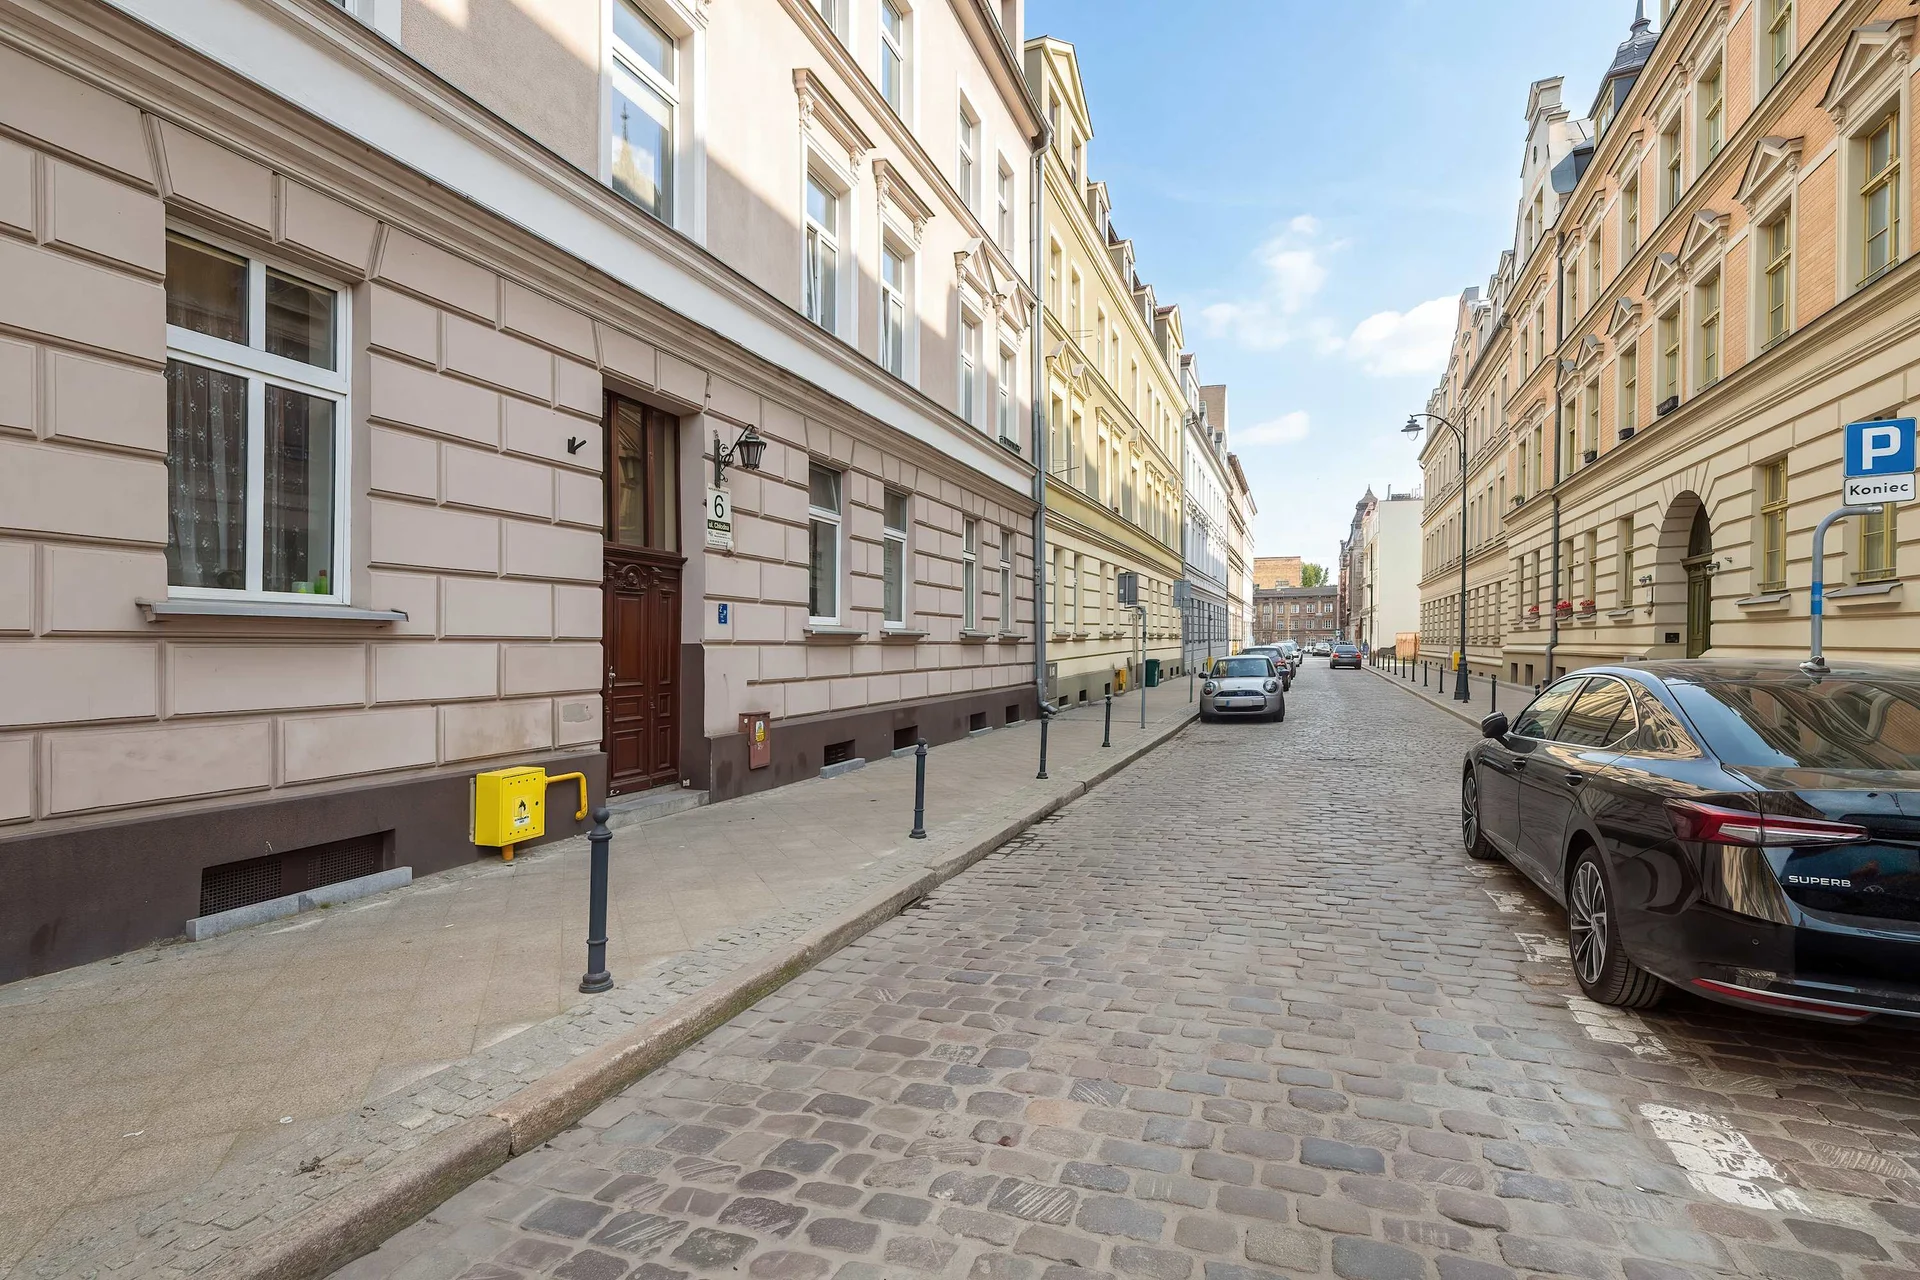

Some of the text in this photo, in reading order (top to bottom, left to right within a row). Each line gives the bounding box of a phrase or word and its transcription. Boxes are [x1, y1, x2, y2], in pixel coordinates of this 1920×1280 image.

[1862, 426, 1901, 470] P
[1849, 482, 1909, 496] Koniec
[714, 494, 724, 519] 6
[1788, 875, 1852, 888] SUPERB
